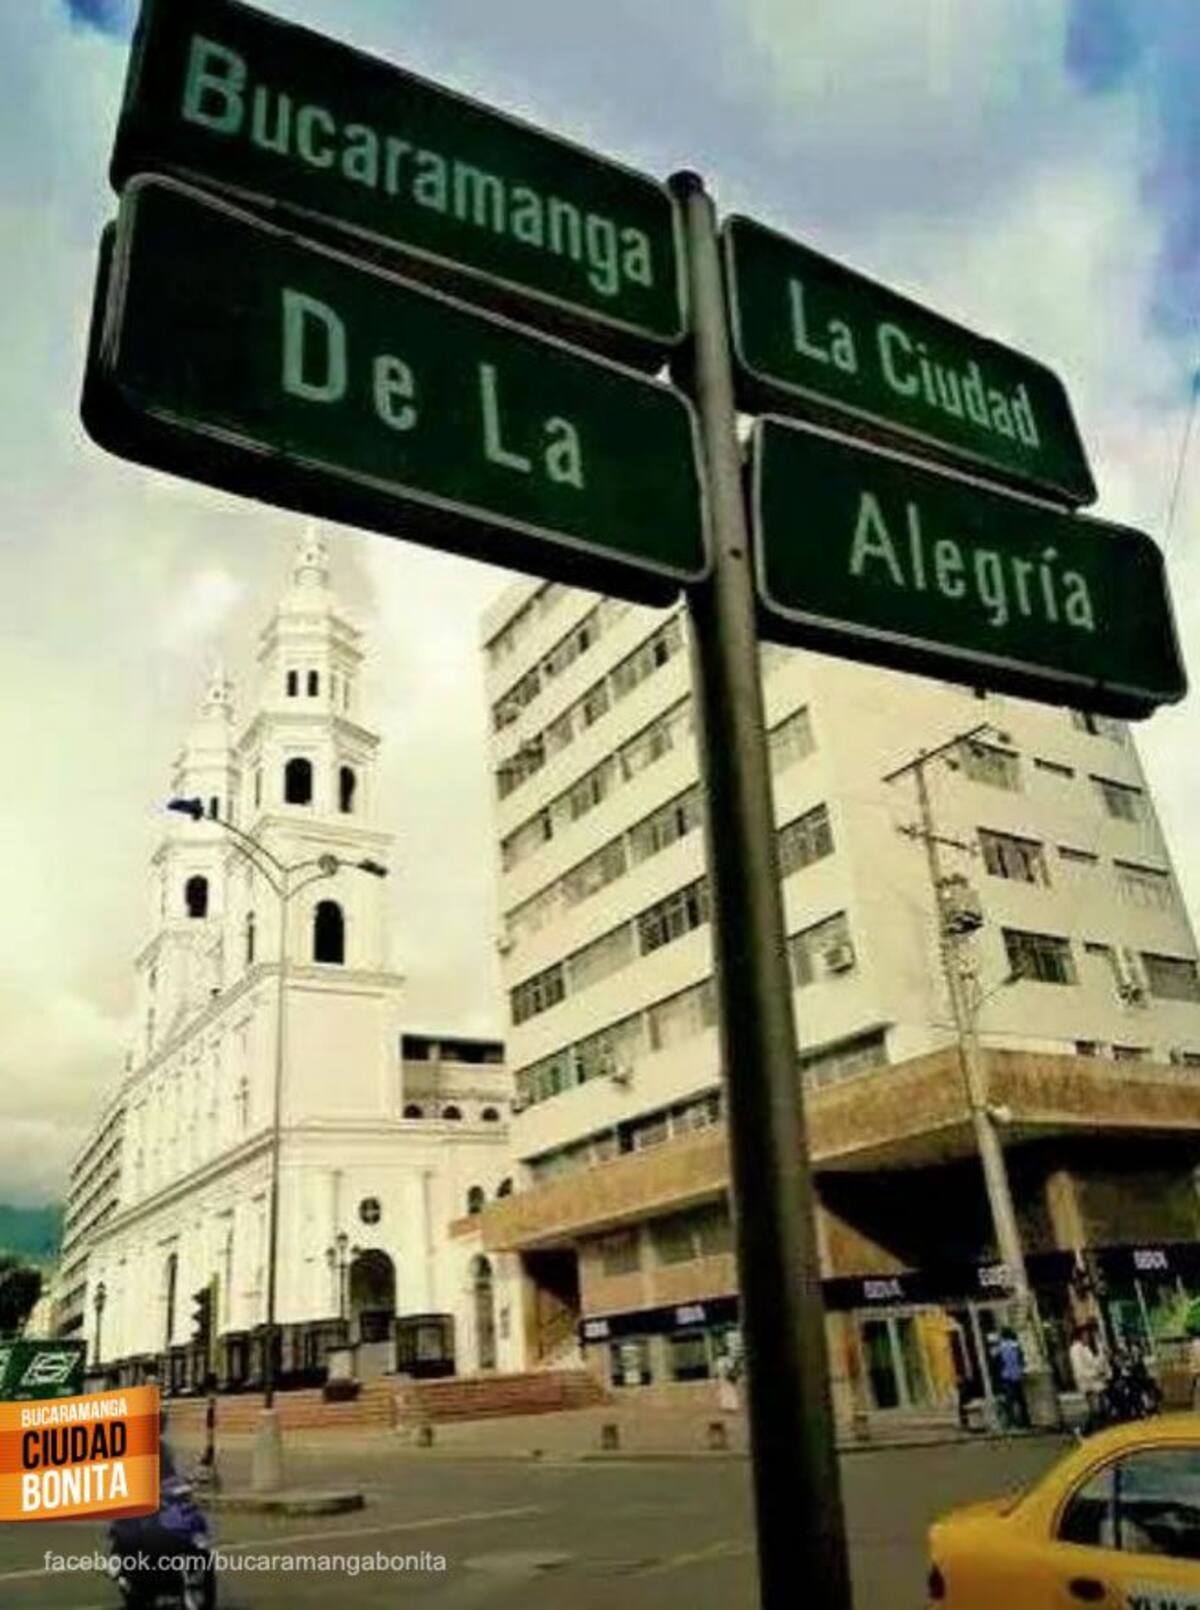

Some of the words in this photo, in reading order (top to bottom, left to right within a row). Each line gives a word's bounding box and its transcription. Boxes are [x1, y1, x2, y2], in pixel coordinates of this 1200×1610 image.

[181, 35, 653, 297] Bucaramanga
[281, 287, 418, 431] De
[479, 363, 585, 489] La
[789, 278, 857, 374] La
[877, 322, 1040, 449] Ciudad
[849, 491, 1096, 631] Alegría
